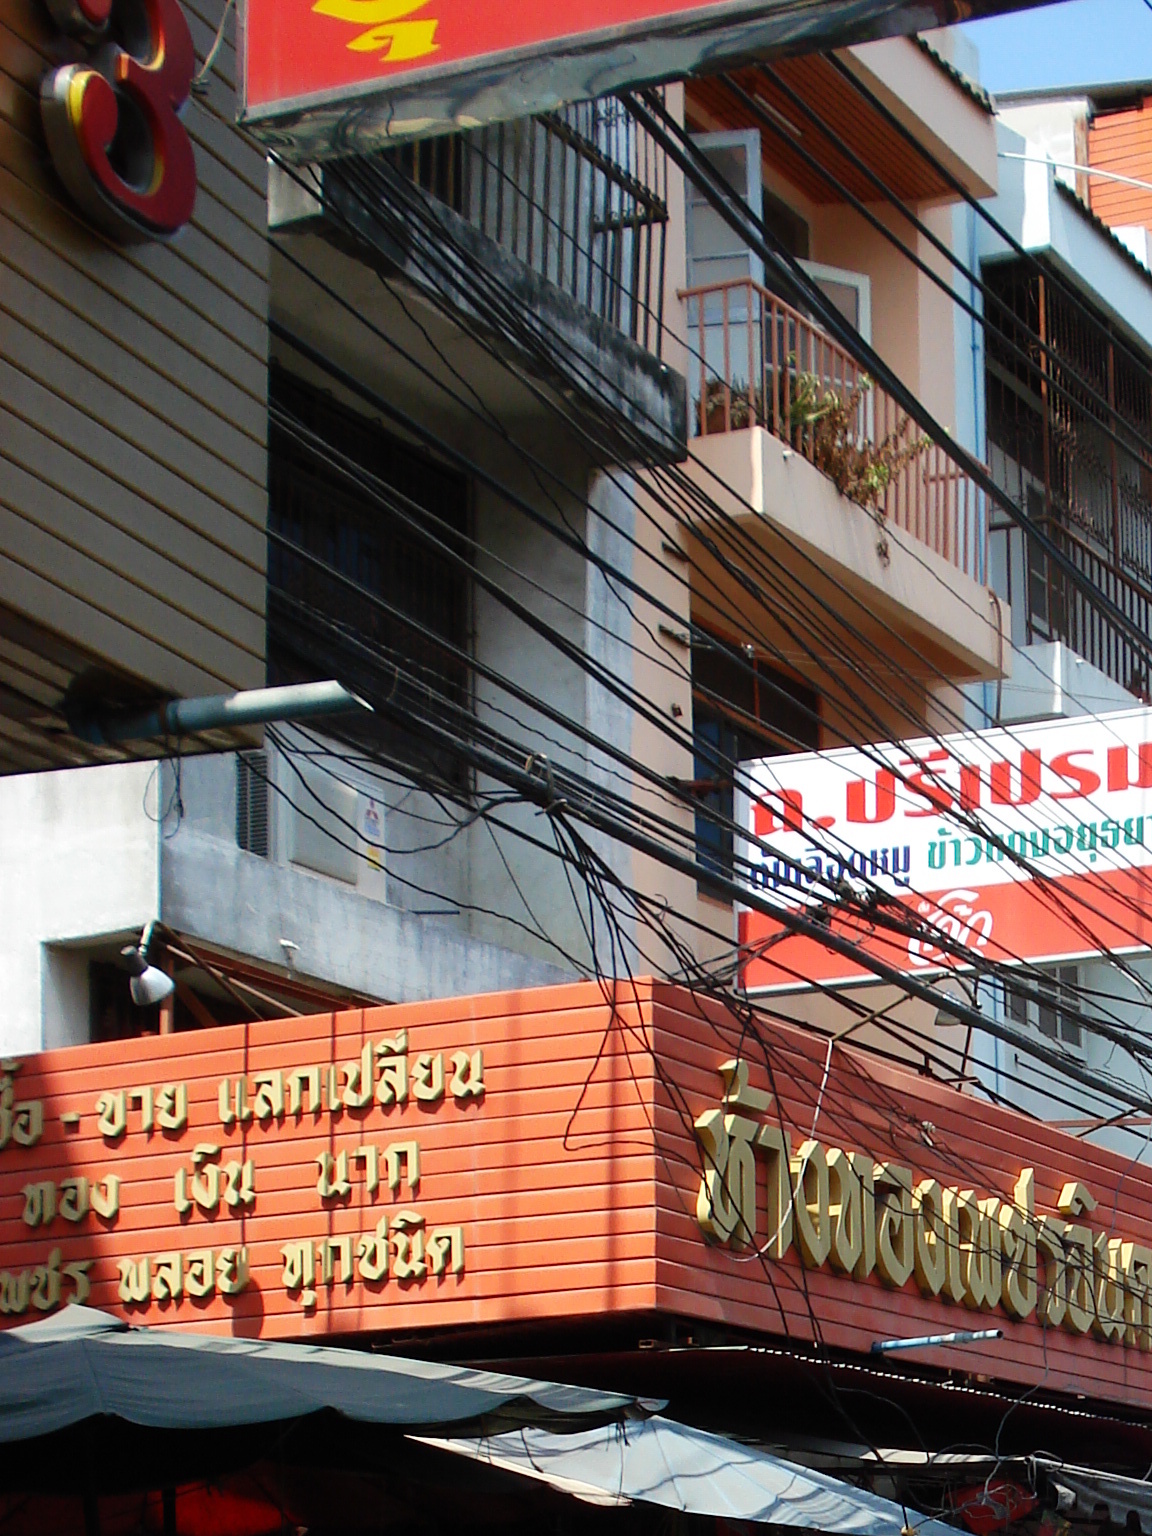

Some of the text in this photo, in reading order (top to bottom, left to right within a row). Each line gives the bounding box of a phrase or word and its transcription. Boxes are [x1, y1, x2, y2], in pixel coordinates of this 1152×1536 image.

[96, 1084, 188, 1137] ขาย
[218, 1029, 486, 1123] แลกเปลี่ยน
[21, 1140, 422, 1227] ทอง เงิน นาก
[116, 1245, 249, 1304] พลอย
[280, 1210, 465, 1308] ทุกชนิด
